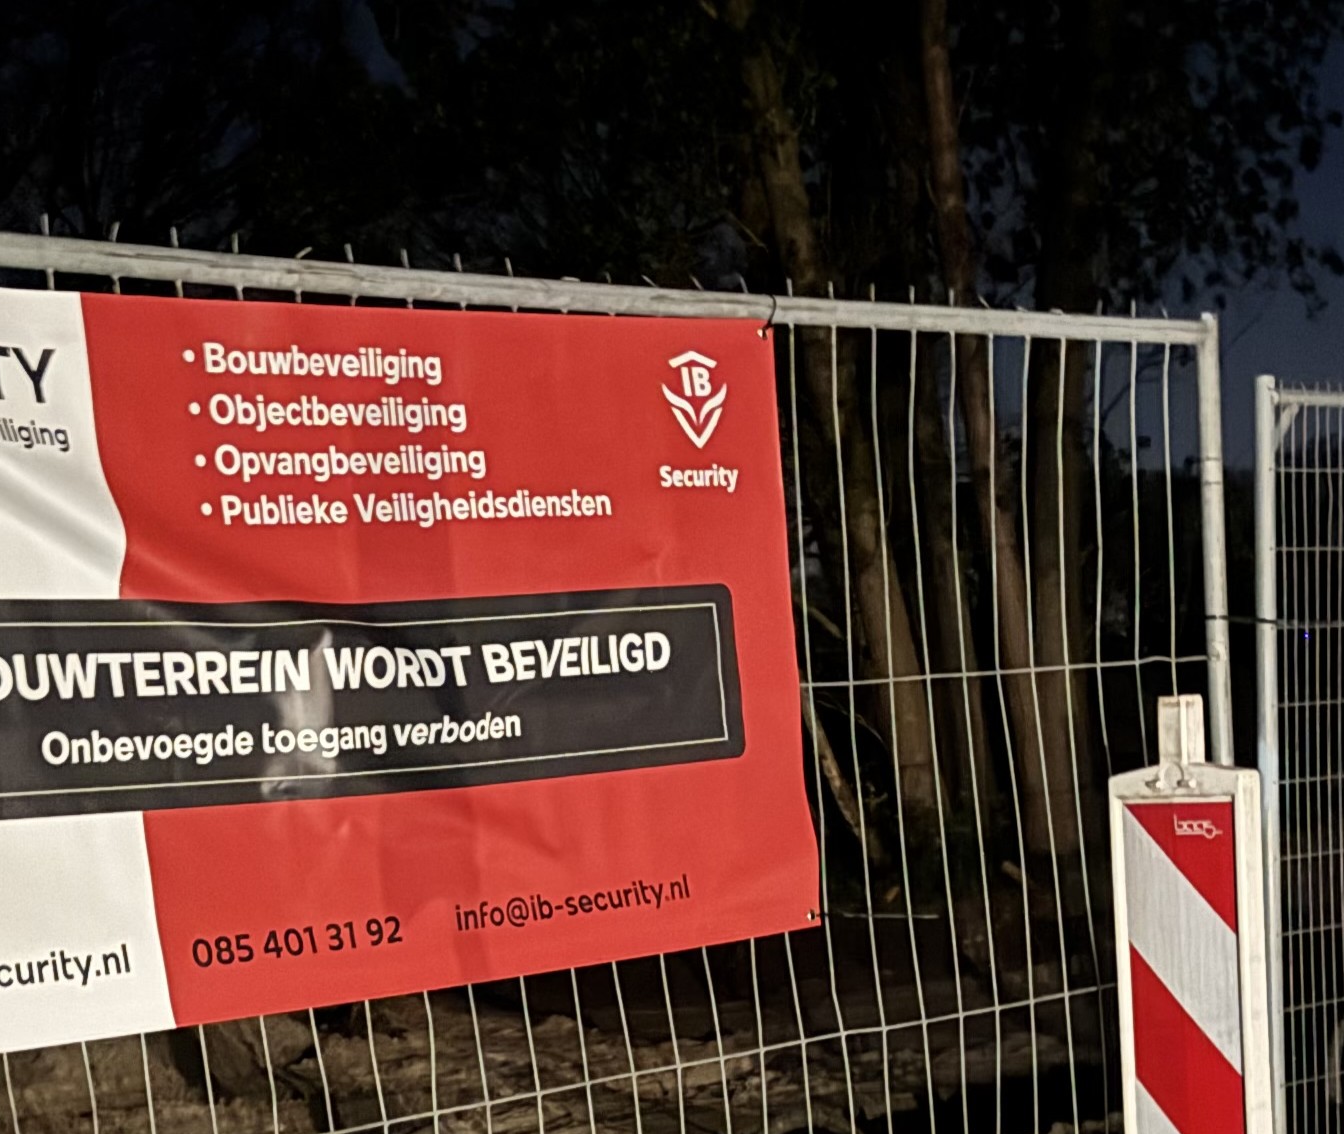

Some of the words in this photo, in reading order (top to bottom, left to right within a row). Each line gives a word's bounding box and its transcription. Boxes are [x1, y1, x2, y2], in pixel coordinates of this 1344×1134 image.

[202, 342, 442, 386] Bouwbeveiliging
[680, 363, 713, 398] IB
[209, 393, 467, 434] Objectbeveiliging
[214, 443, 487, 483] Opvangbeveiliging
[659, 463, 739, 493] Security
[220, 493, 349, 526] Publieke
[352, 488, 612, 528] Veiligheidsdiensten
[322, 645, 472, 688] WORDT
[481, 631, 671, 683] BEVEILIGD
[41, 724, 254, 765] Onbevoegde
[261, 722, 388, 759] toegang
[392, 711, 522, 747] verboden
[455, 873, 691, 932] info@ib-security.nl
[192, 933, 255, 968] 085
[263, 926, 318, 959] 401
[325, 921, 357, 952] 31
[365, 915, 403, 947] 92
